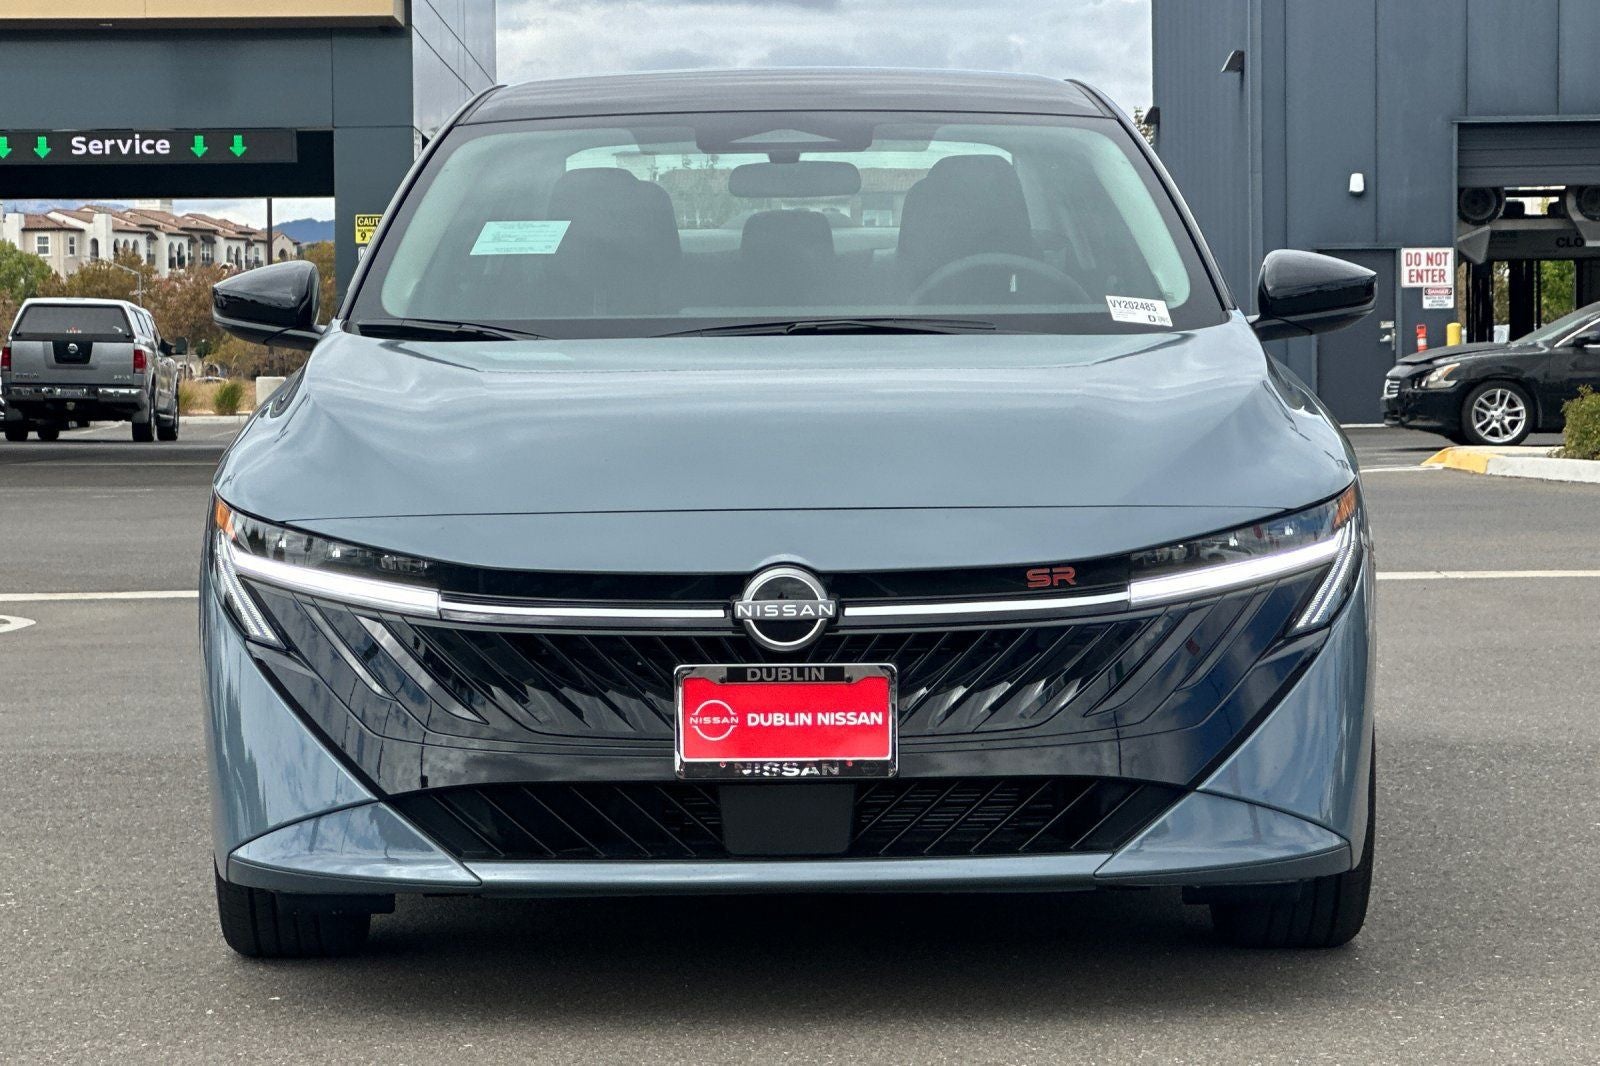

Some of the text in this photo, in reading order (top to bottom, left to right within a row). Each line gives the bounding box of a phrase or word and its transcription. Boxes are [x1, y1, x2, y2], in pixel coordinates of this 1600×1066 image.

[71, 134, 171, 155] Service
[358, 217, 380, 226] CAUT
[1405, 252, 1449, 267] DO NOT
[1408, 269, 1446, 283] ENTER
[1110, 299, 1157, 312] VY202485
[1026, 566, 1077, 588] SR
[737, 604, 834, 617] NISSAN
[746, 667, 825, 682] DUBLIN
[689, 716, 739, 725] NISSAN
[747, 711, 883, 726] DUBLIN NISSAN
[734, 762, 840, 777] NISSAN
